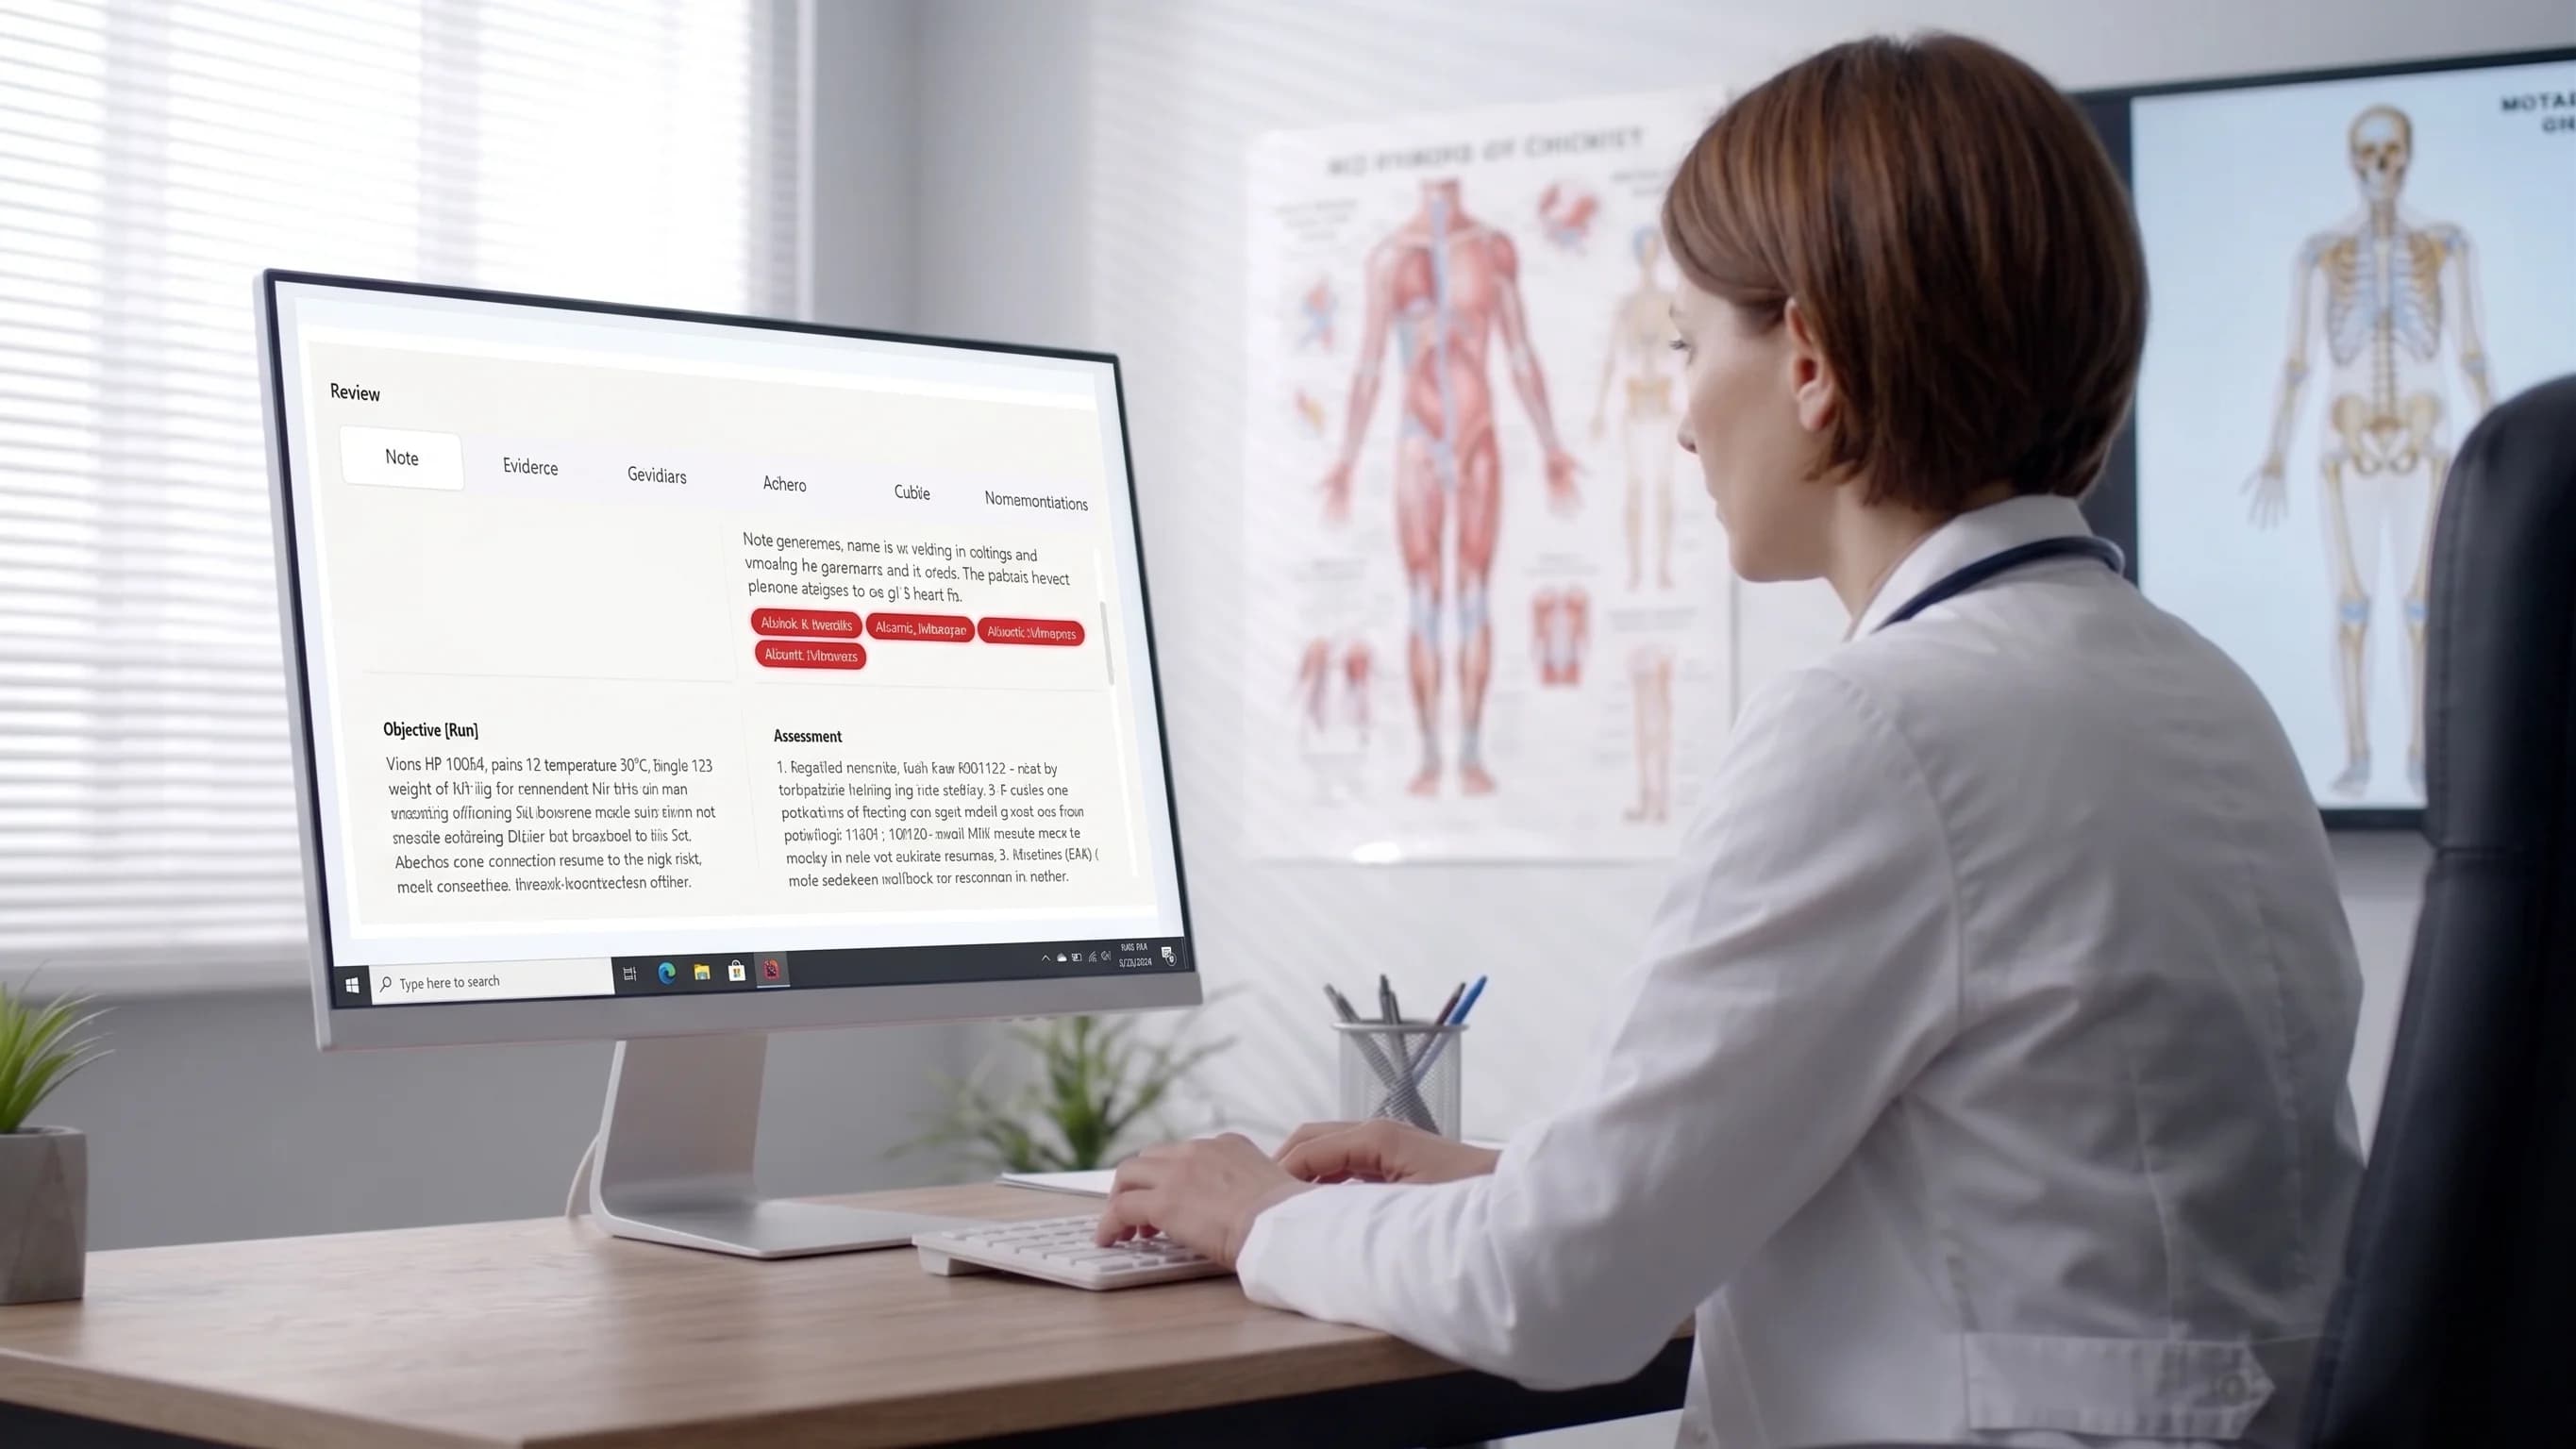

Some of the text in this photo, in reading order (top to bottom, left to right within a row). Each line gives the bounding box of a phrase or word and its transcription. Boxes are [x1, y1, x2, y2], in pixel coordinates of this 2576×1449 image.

[330, 383, 380, 402] Review
[386, 449, 418, 466] Note
[744, 532, 773, 547] Note
[777, 538, 844, 552] generemes,
[847, 541, 880, 553] name
[884, 541, 893, 554] is
[956, 544, 965, 558] in
[1016, 549, 1037, 561] and
[802, 558, 817, 573] he
[887, 563, 909, 576] and
[962, 567, 985, 581] The
[852, 585, 864, 597] to
[913, 587, 944, 601] heart
[384, 721, 478, 740] Objective [Run]
[774, 728, 843, 742] Assessment
[386, 757, 421, 771] Vions
[426, 757, 442, 771] HP
[492, 761, 523, 774] pains
[527, 758, 541, 771] 12
[544, 759, 617, 775] temperature
[692, 759, 712, 772] 123
[778, 760, 787, 774] 1.
[1045, 762, 1057, 777] by
[389, 781, 432, 799] weight
[436, 781, 449, 795] of
[496, 781, 513, 795] for
[662, 786, 687, 795] man
[895, 784, 913, 799] ing
[1047, 787, 1068, 795] one
[696, 807, 716, 818] not
[847, 806, 860, 818] of
[635, 830, 647, 841] to
[395, 855, 449, 869] Abechos
[454, 858, 484, 868] cone
[489, 854, 555, 867] connection
[560, 857, 604, 866] resume
[608, 854, 620, 865] to
[624, 853, 644, 865] the
[831, 851, 842, 863] in
[846, 851, 870, 863] nele
[874, 852, 893, 862] vot
[999, 849, 1009, 860] 3.
[823, 873, 878, 886] sedekeen
[400, 974, 499, 992] Type here to search
